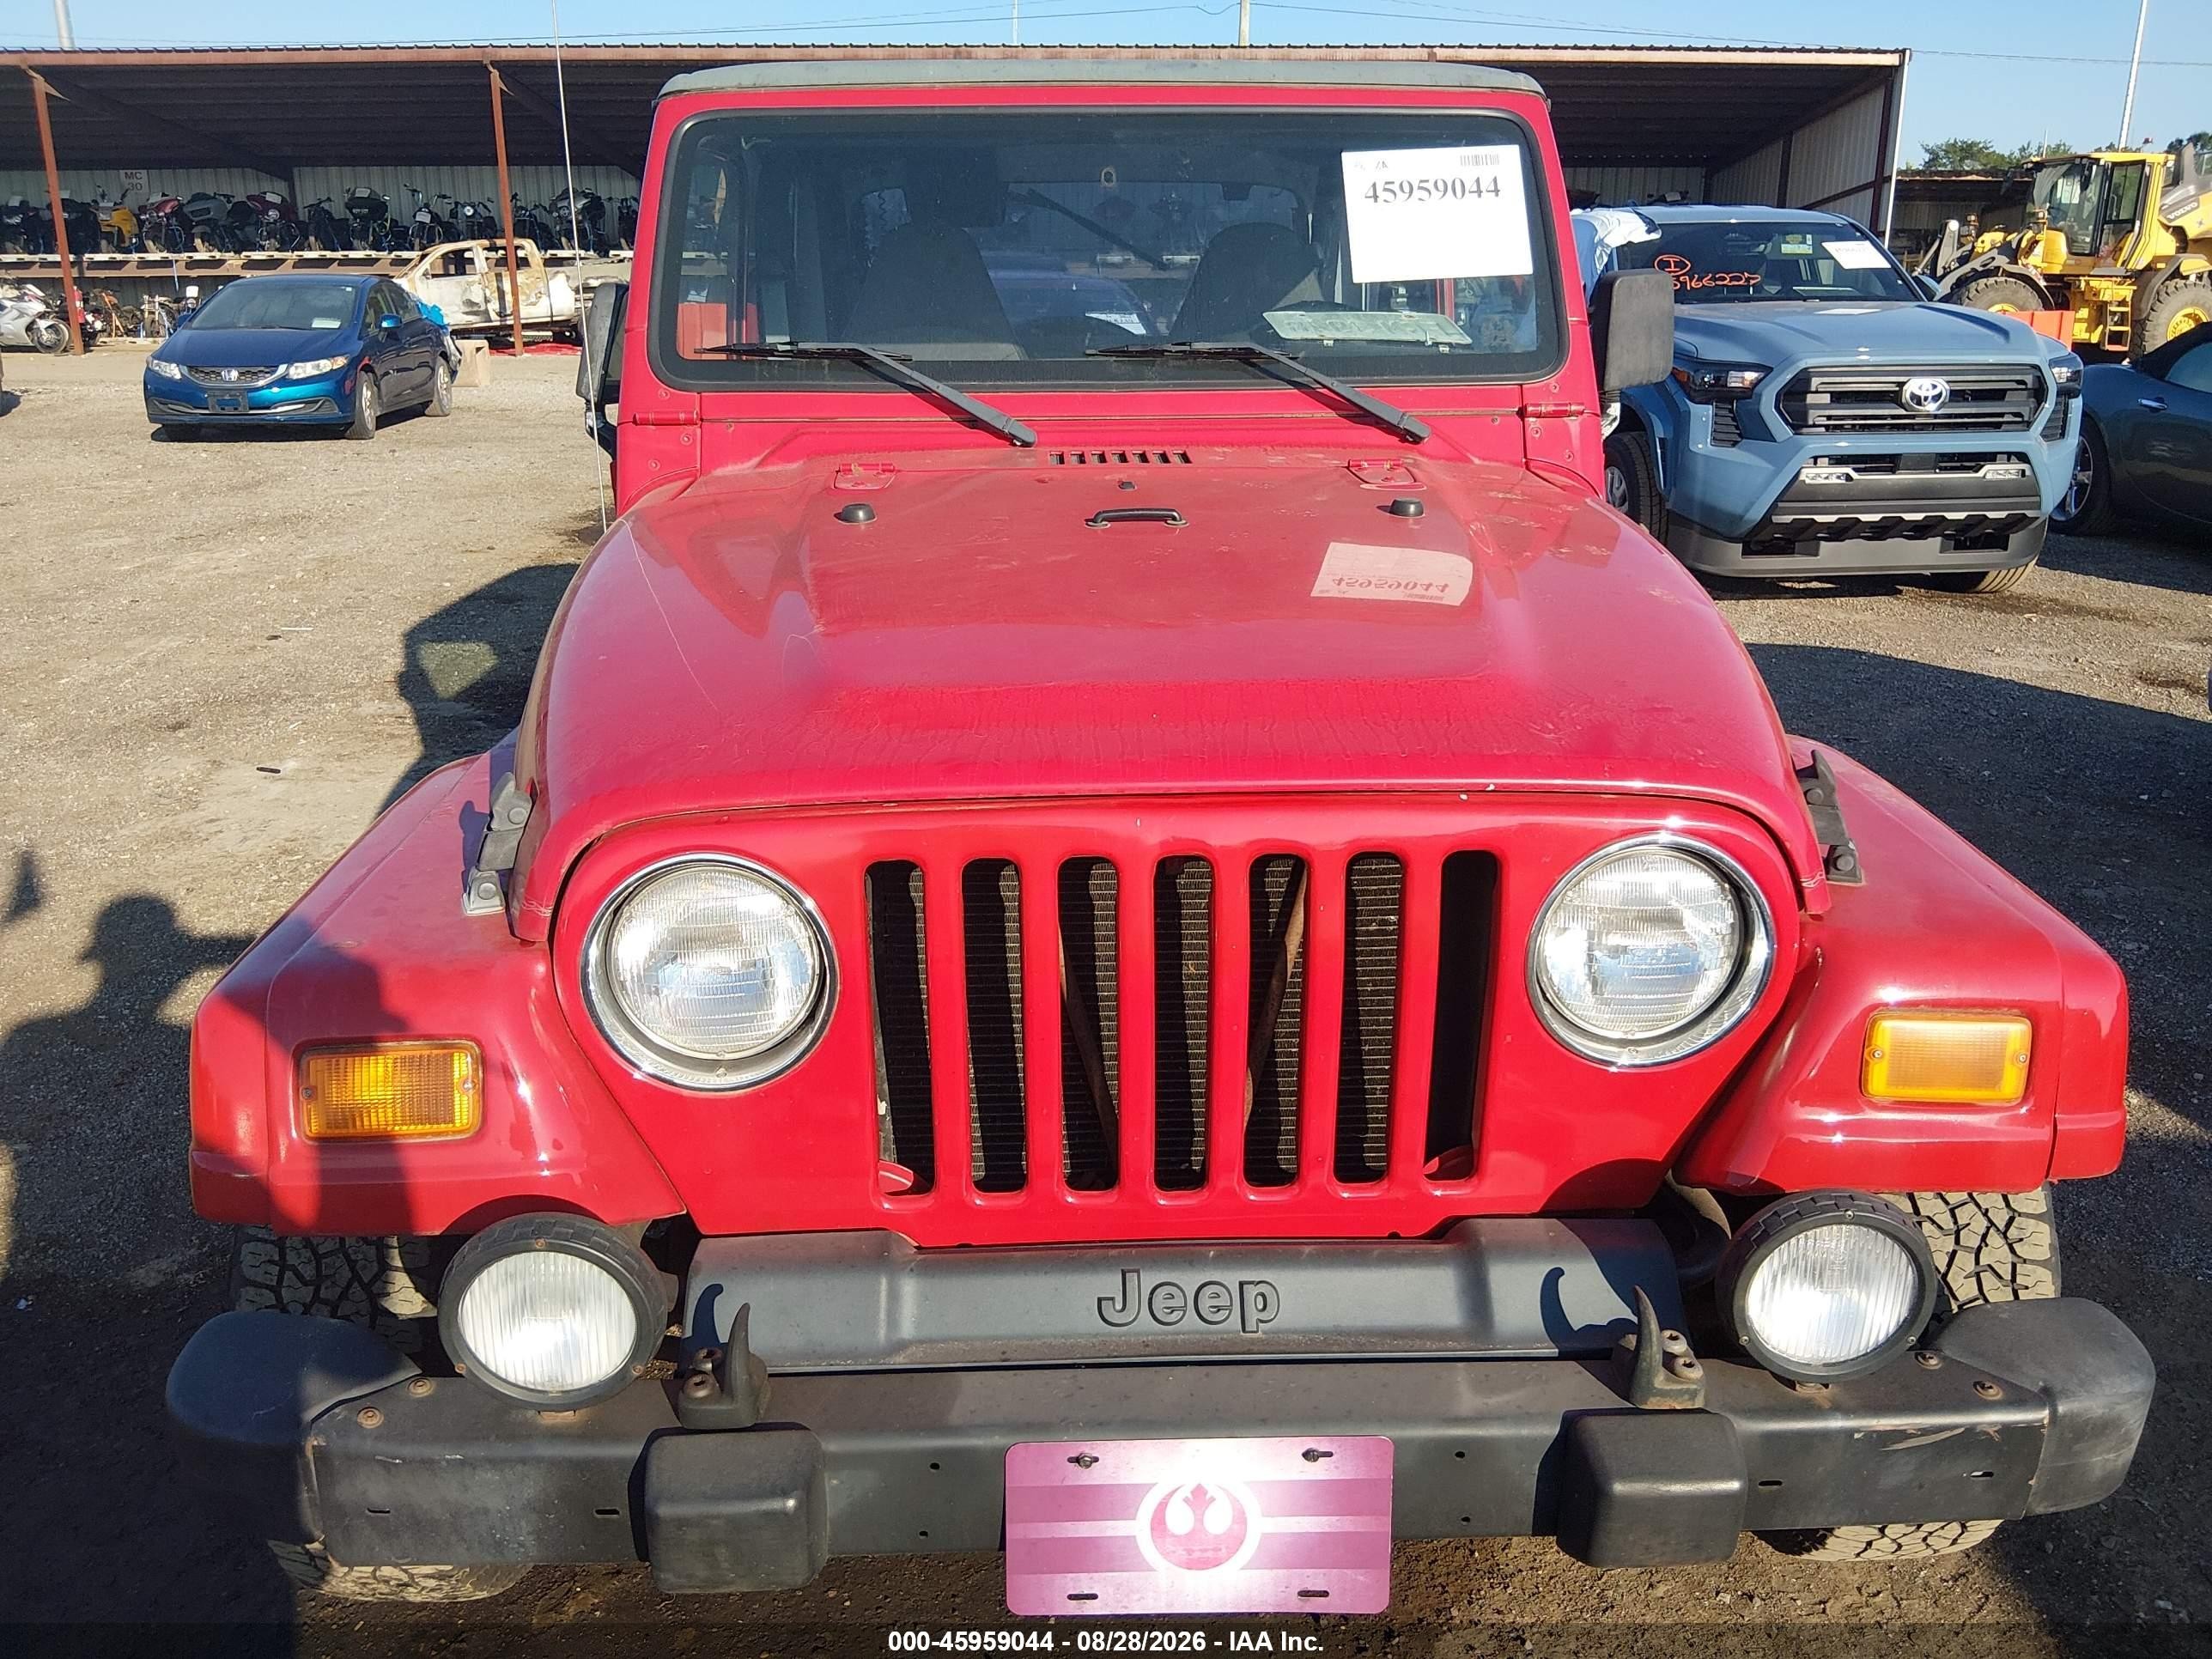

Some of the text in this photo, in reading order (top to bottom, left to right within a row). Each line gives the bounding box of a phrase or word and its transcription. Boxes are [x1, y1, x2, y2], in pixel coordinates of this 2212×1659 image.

[124, 171, 143, 180] MC
[127, 182, 143, 191] 30
[1364, 174, 1501, 204] 45959044
[2166, 202, 2199, 220] VOLVO
[1097, 1267, 1280, 1334] Jeep
